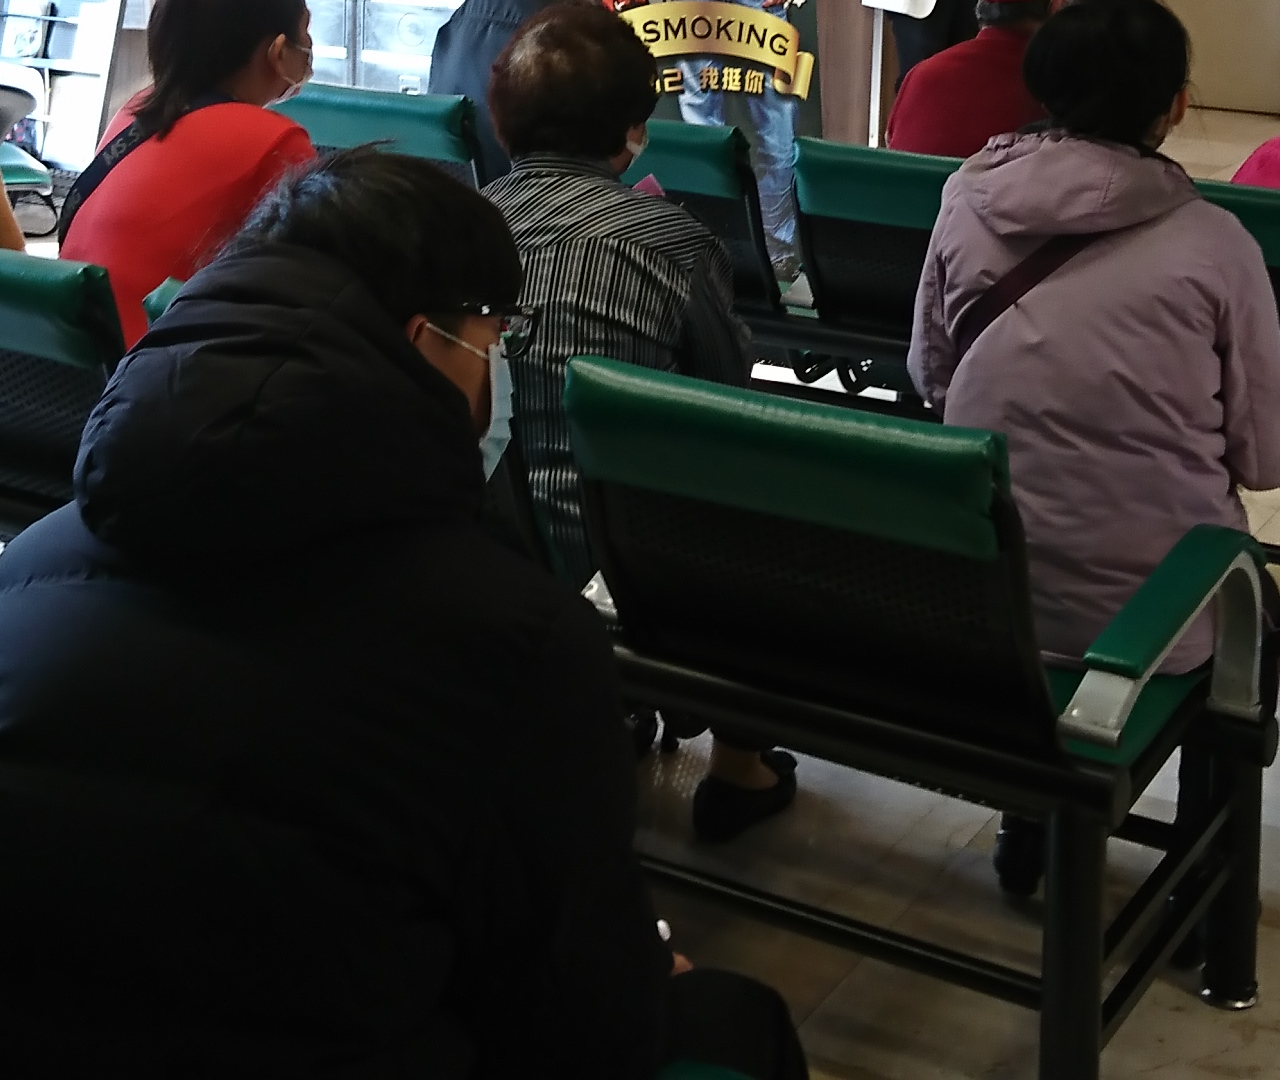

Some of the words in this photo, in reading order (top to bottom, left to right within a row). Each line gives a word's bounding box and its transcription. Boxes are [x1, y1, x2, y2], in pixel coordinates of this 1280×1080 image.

[643, 16, 789, 56] SMOKING
[650, 68, 685, 94] 己
[700, 66, 765, 95] 我挺你
